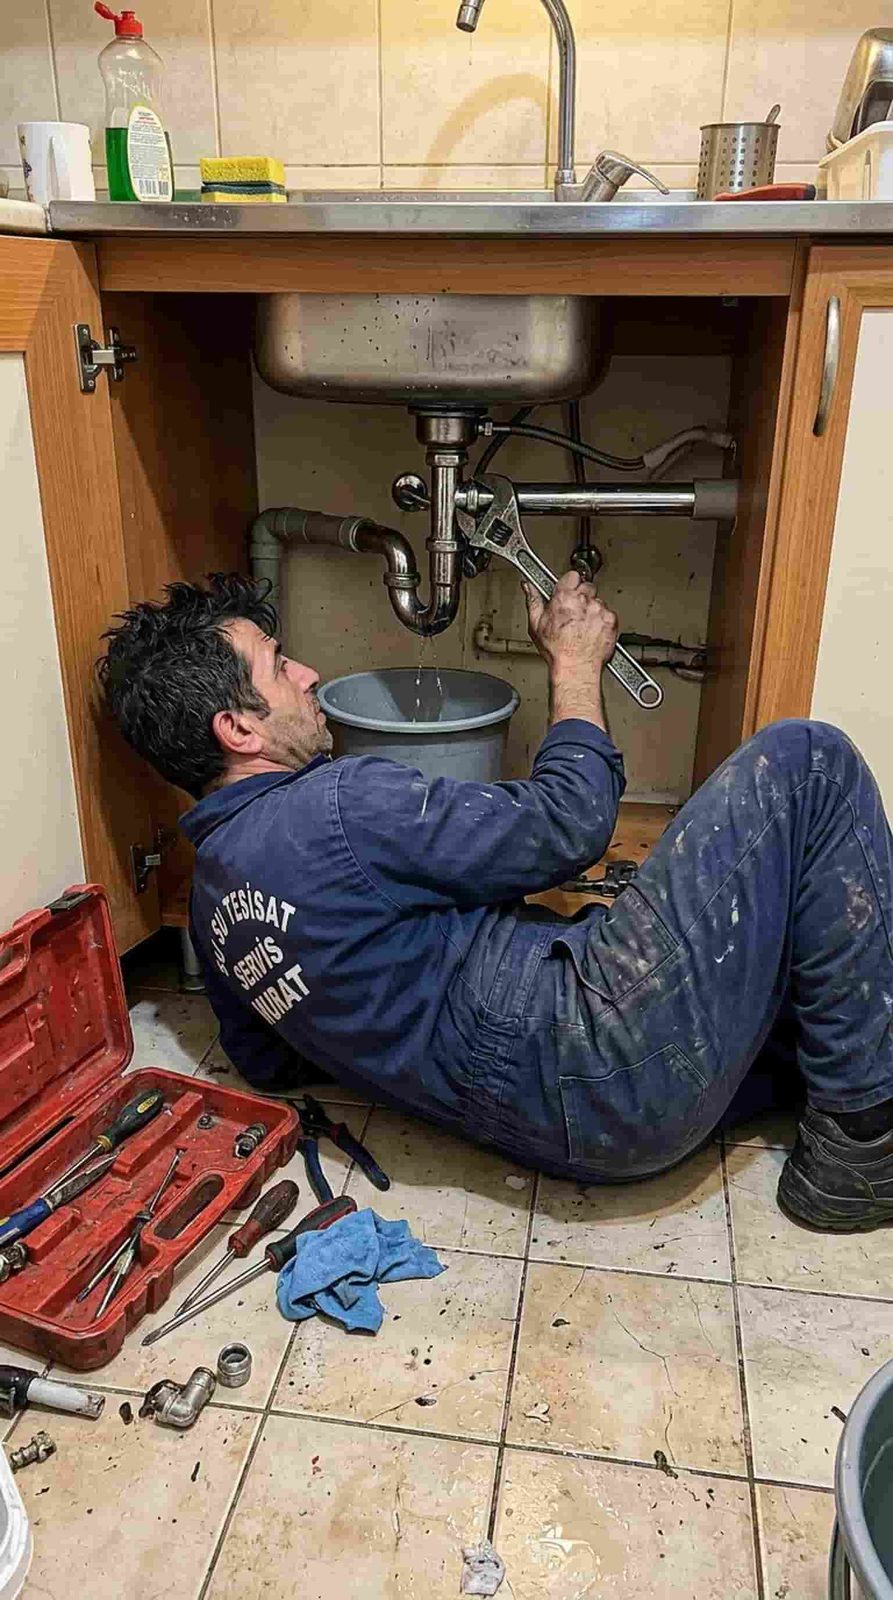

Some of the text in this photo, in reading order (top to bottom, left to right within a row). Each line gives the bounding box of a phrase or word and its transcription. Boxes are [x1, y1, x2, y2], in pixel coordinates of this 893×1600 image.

[211, 906, 229, 945] SU
[221, 881, 296, 933] TESİSAT
[233, 936, 284, 990] SERVİS
